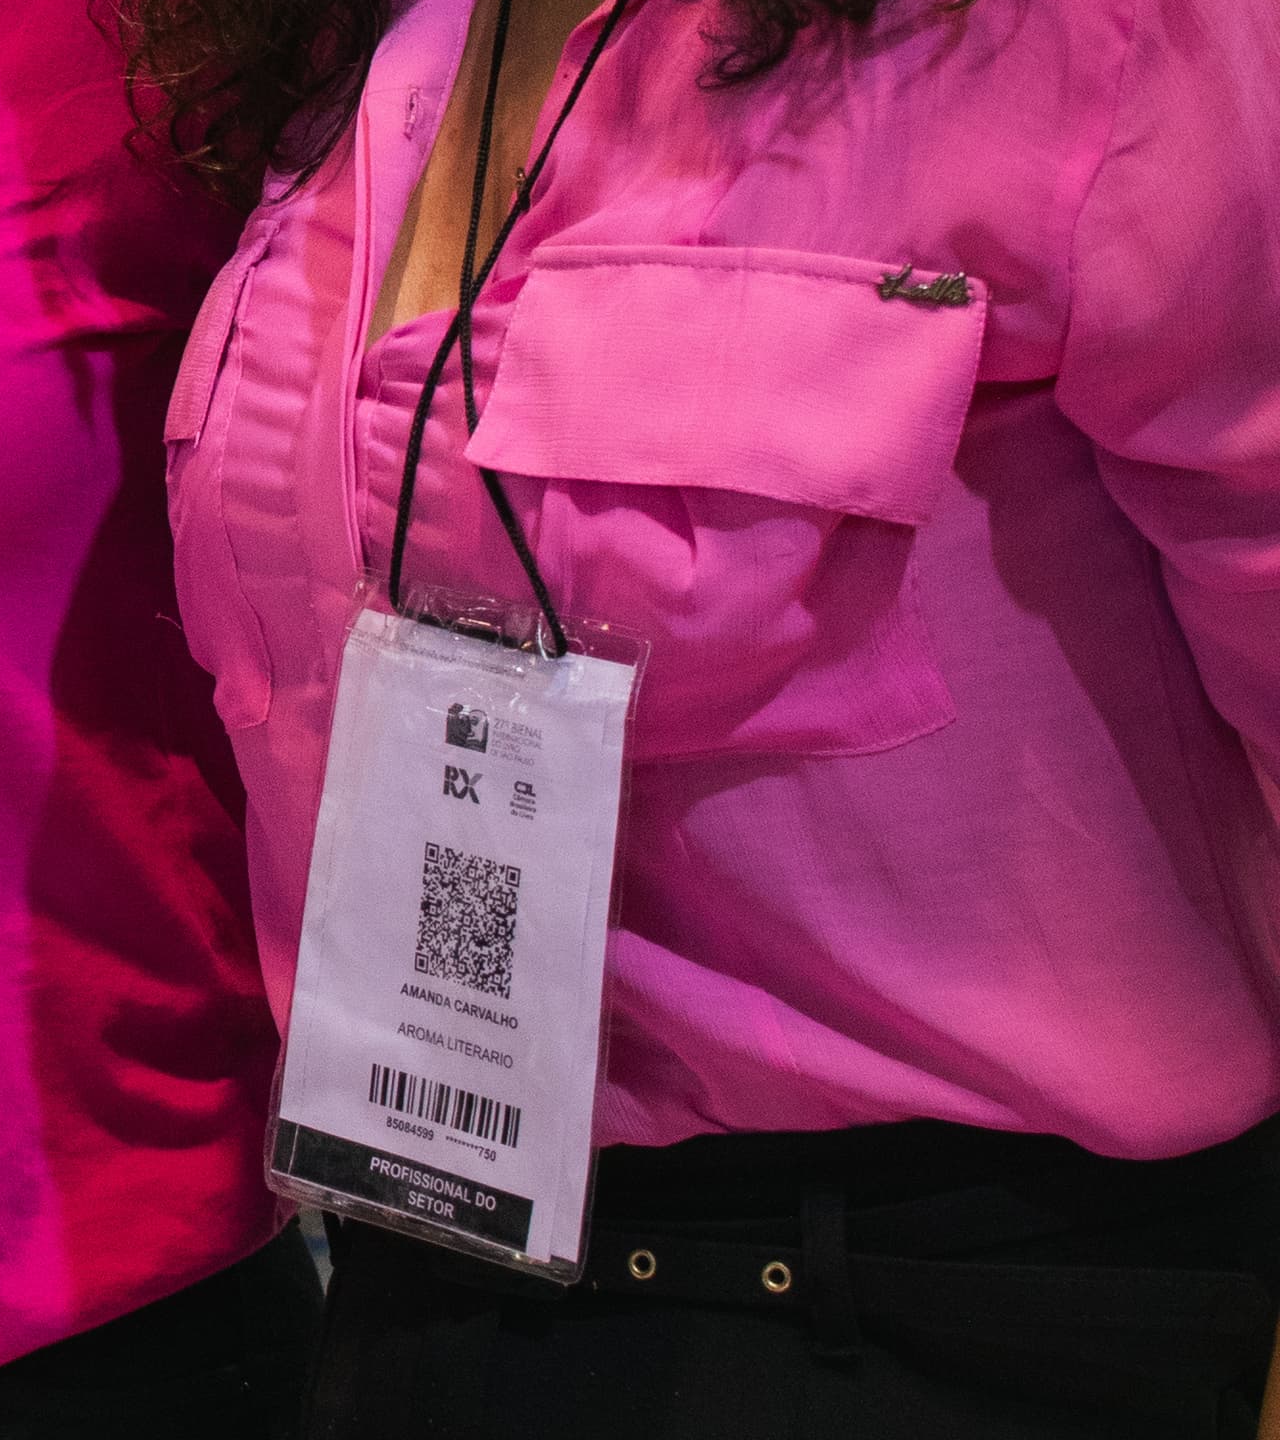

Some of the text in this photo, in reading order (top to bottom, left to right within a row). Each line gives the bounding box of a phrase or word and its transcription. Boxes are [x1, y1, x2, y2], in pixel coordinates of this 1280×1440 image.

[443, 764, 484, 805] RX
[400, 983, 518, 1030] AMANDA CARVALHO
[397, 1022, 513, 1069] AROMA LITERARIO
[370, 1156, 497, 1212] PROFISSIONAL DO
[407, 1191, 455, 1219] SETOR
